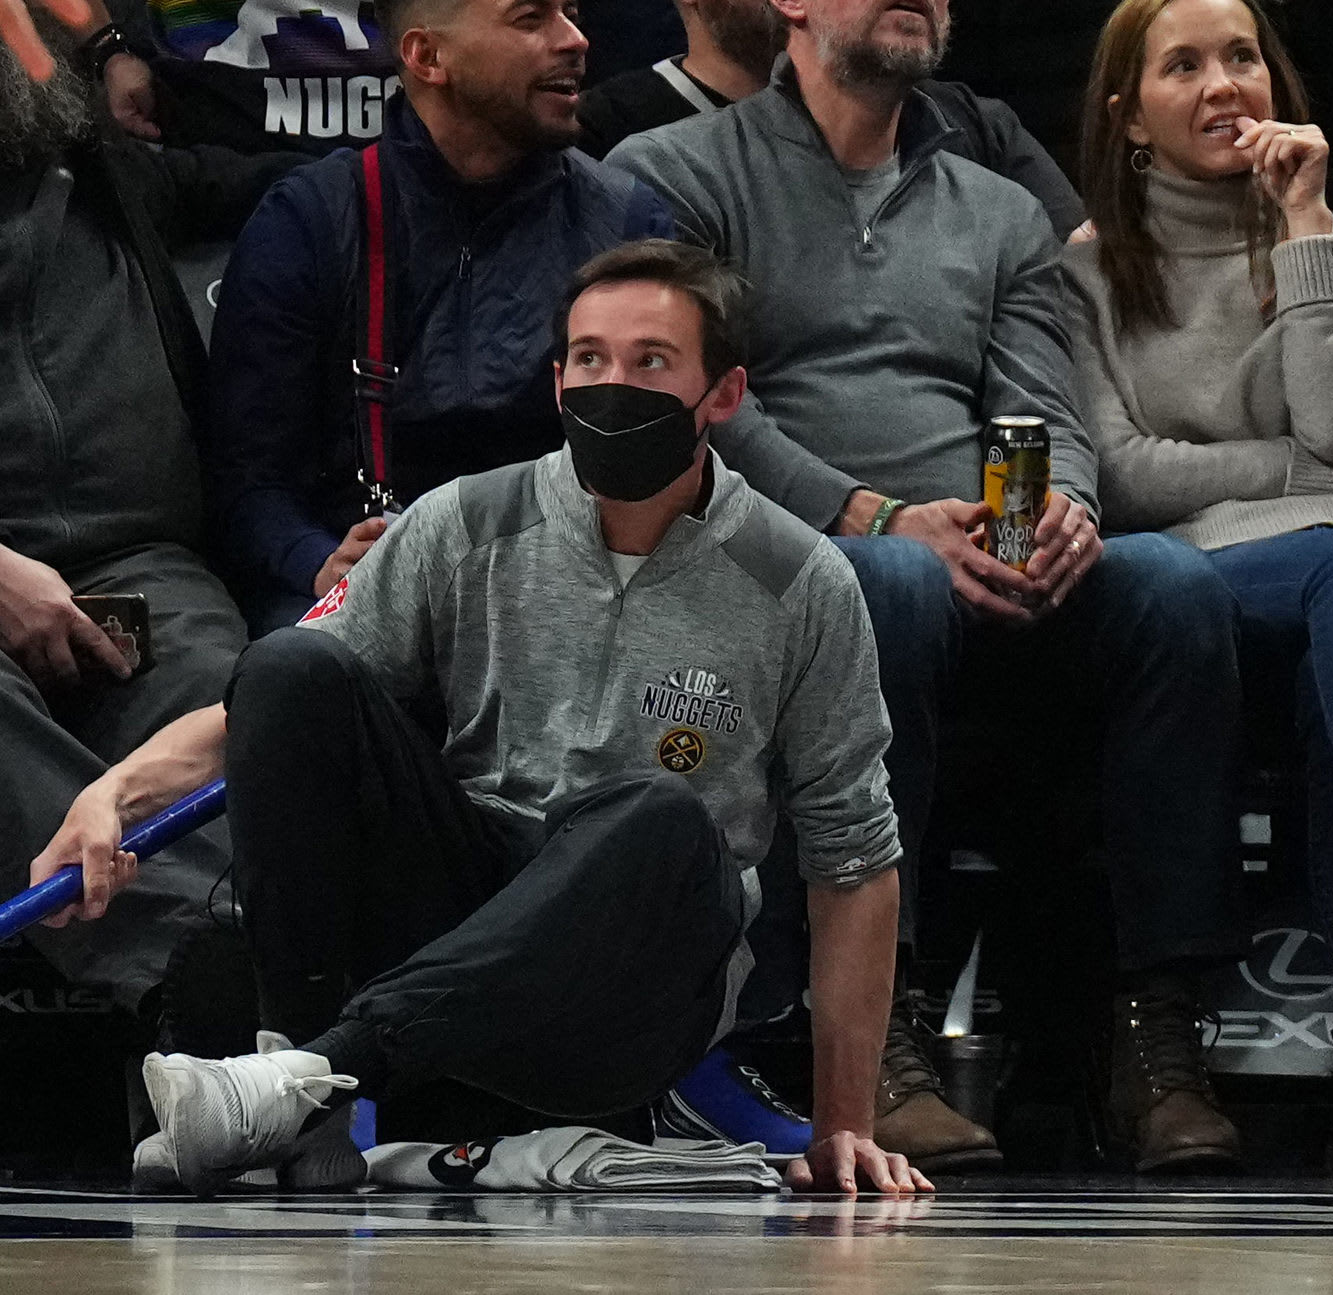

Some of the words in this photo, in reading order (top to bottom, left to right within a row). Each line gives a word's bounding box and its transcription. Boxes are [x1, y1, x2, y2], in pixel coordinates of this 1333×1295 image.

[264, 75, 404, 138] NUG
[996, 521, 1034, 542] VOOD
[997, 542, 1034, 561] RAN
[684, 668, 717, 697] LOS
[640, 683, 744, 735] NUGGETS
